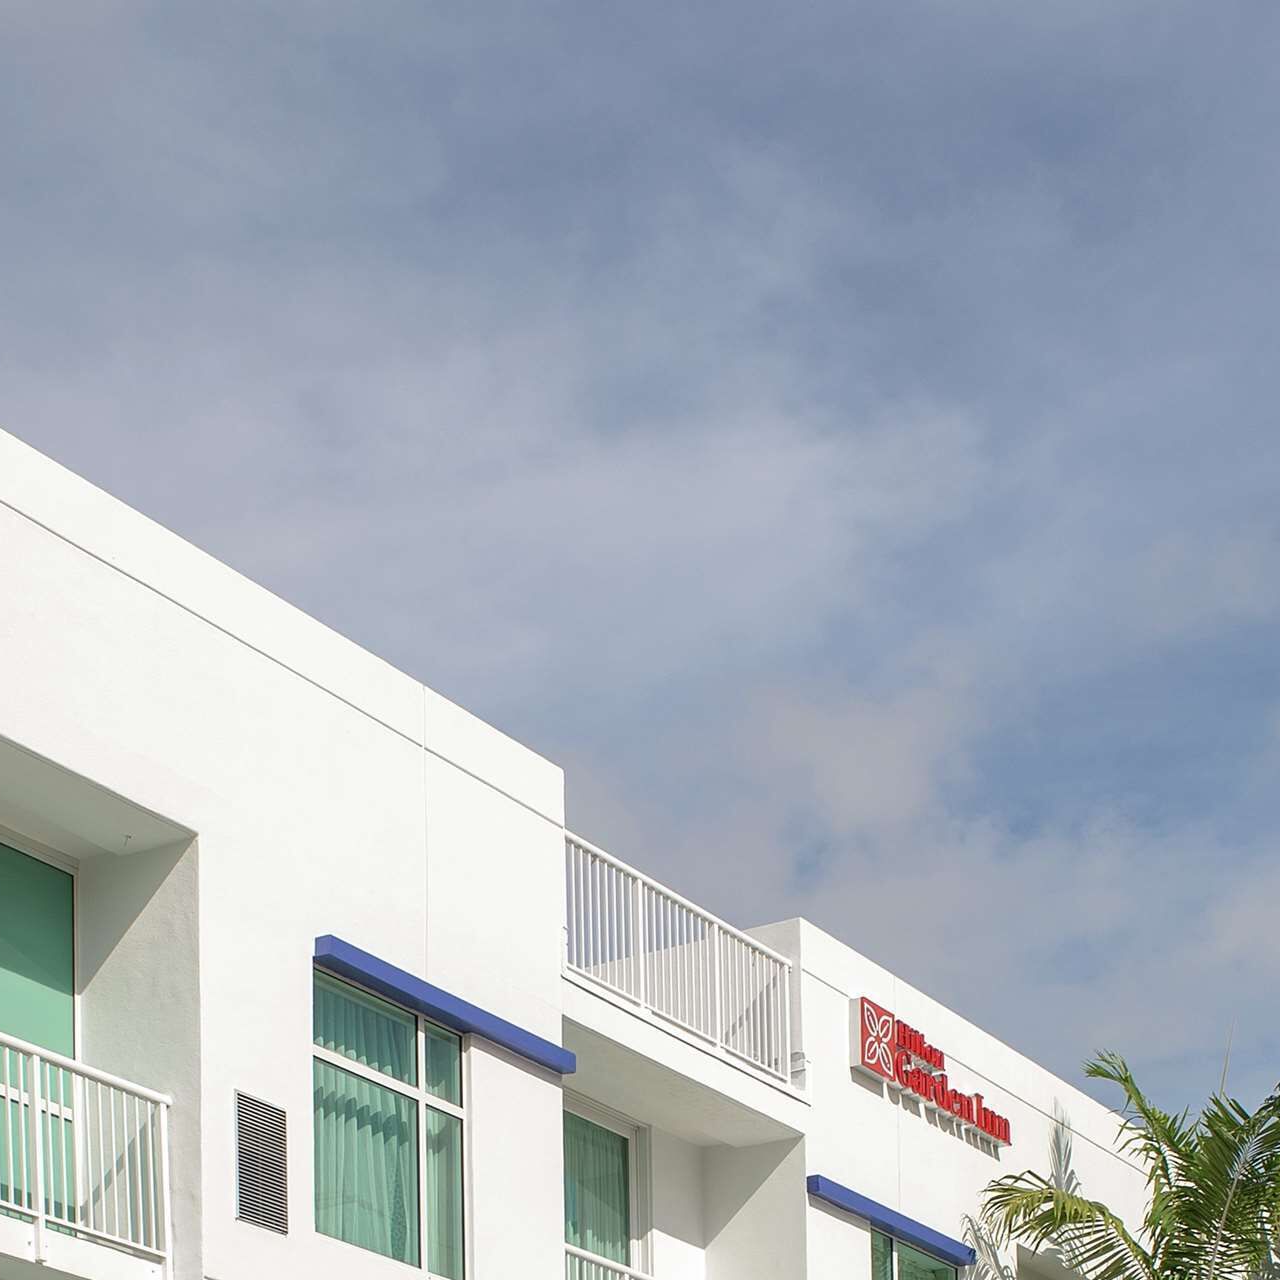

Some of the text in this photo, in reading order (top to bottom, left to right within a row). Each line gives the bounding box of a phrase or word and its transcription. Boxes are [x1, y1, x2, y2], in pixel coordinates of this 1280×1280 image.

[895, 1019, 945, 1071] Hilton
[895, 1050, 1012, 1146] Garden Inn
